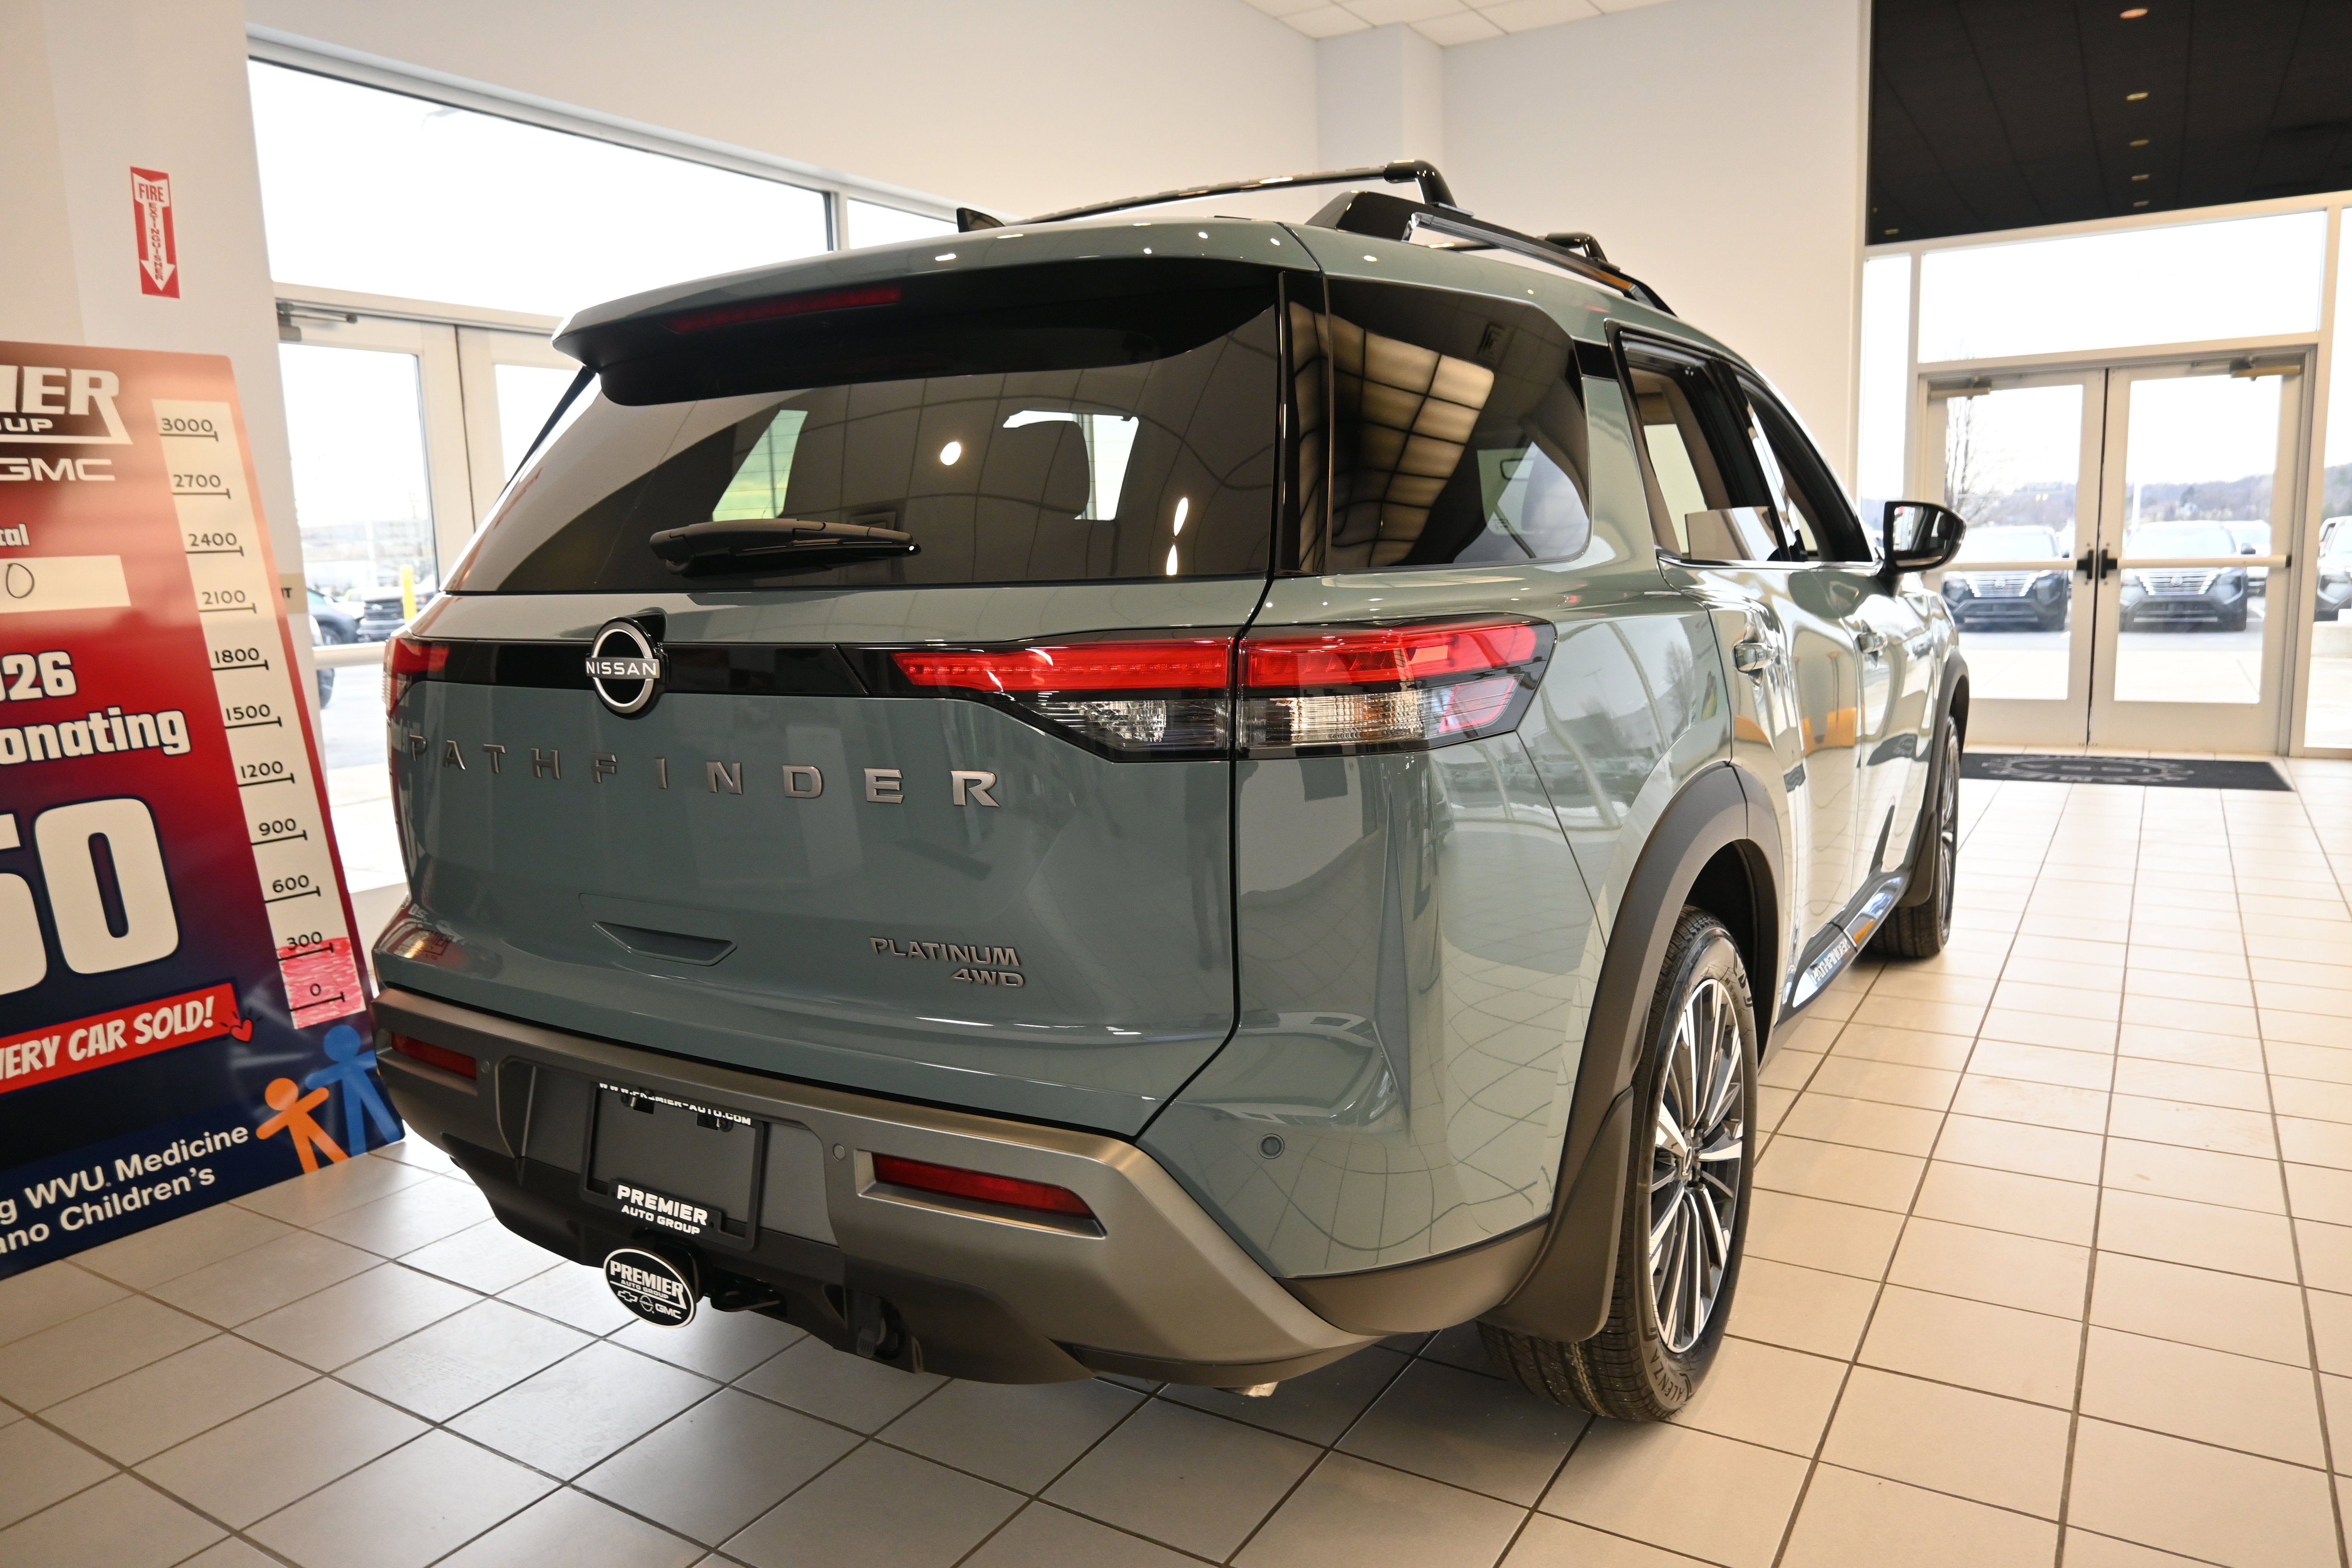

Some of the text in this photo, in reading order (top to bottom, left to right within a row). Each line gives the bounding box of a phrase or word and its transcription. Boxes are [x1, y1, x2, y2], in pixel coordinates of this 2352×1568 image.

[139, 183, 164, 202] FIRE
[149, 202, 164, 281] EXTINGUISHER
[0, 418, 53, 432] UP
[161, 418, 213, 432] 3000
[0, 457, 115, 481] GMC
[173, 474, 221, 487] 2700
[189, 533, 237, 547] 2400
[202, 590, 246, 605] 2100
[215, 648, 260, 663] 1800
[0, 651, 77, 702] 26
[585, 661, 657, 676] NISSAN
[226, 704, 271, 721] 1500
[0, 706, 191, 765] onating
[240, 761, 283, 779] 1200
[409, 735, 1001, 807] PATHFINDER
[259, 818, 297, 836] 900
[272, 875, 309, 893] 600
[286, 932, 322, 950] 300
[869, 936, 1020, 966] PLATINUM
[1810, 937, 1851, 985] PATHFINDER
[952, 969, 1024, 987] 4WD
[310, 983, 321, 996] 0
[68, 1019, 128, 1062] CAR
[133, 996, 214, 1044] SOLD!
[114, 1127, 248, 1181] Medicine
[60, 1168, 215, 1230] Children's
[617, 1184, 708, 1225] PREMIER
[621, 1205, 700, 1234] AUTO GROUP
[610, 1260, 687, 1309] PREMIER
[621, 1279, 669, 1299] AUTO GROUP
[655, 1303, 682, 1319] GMC
